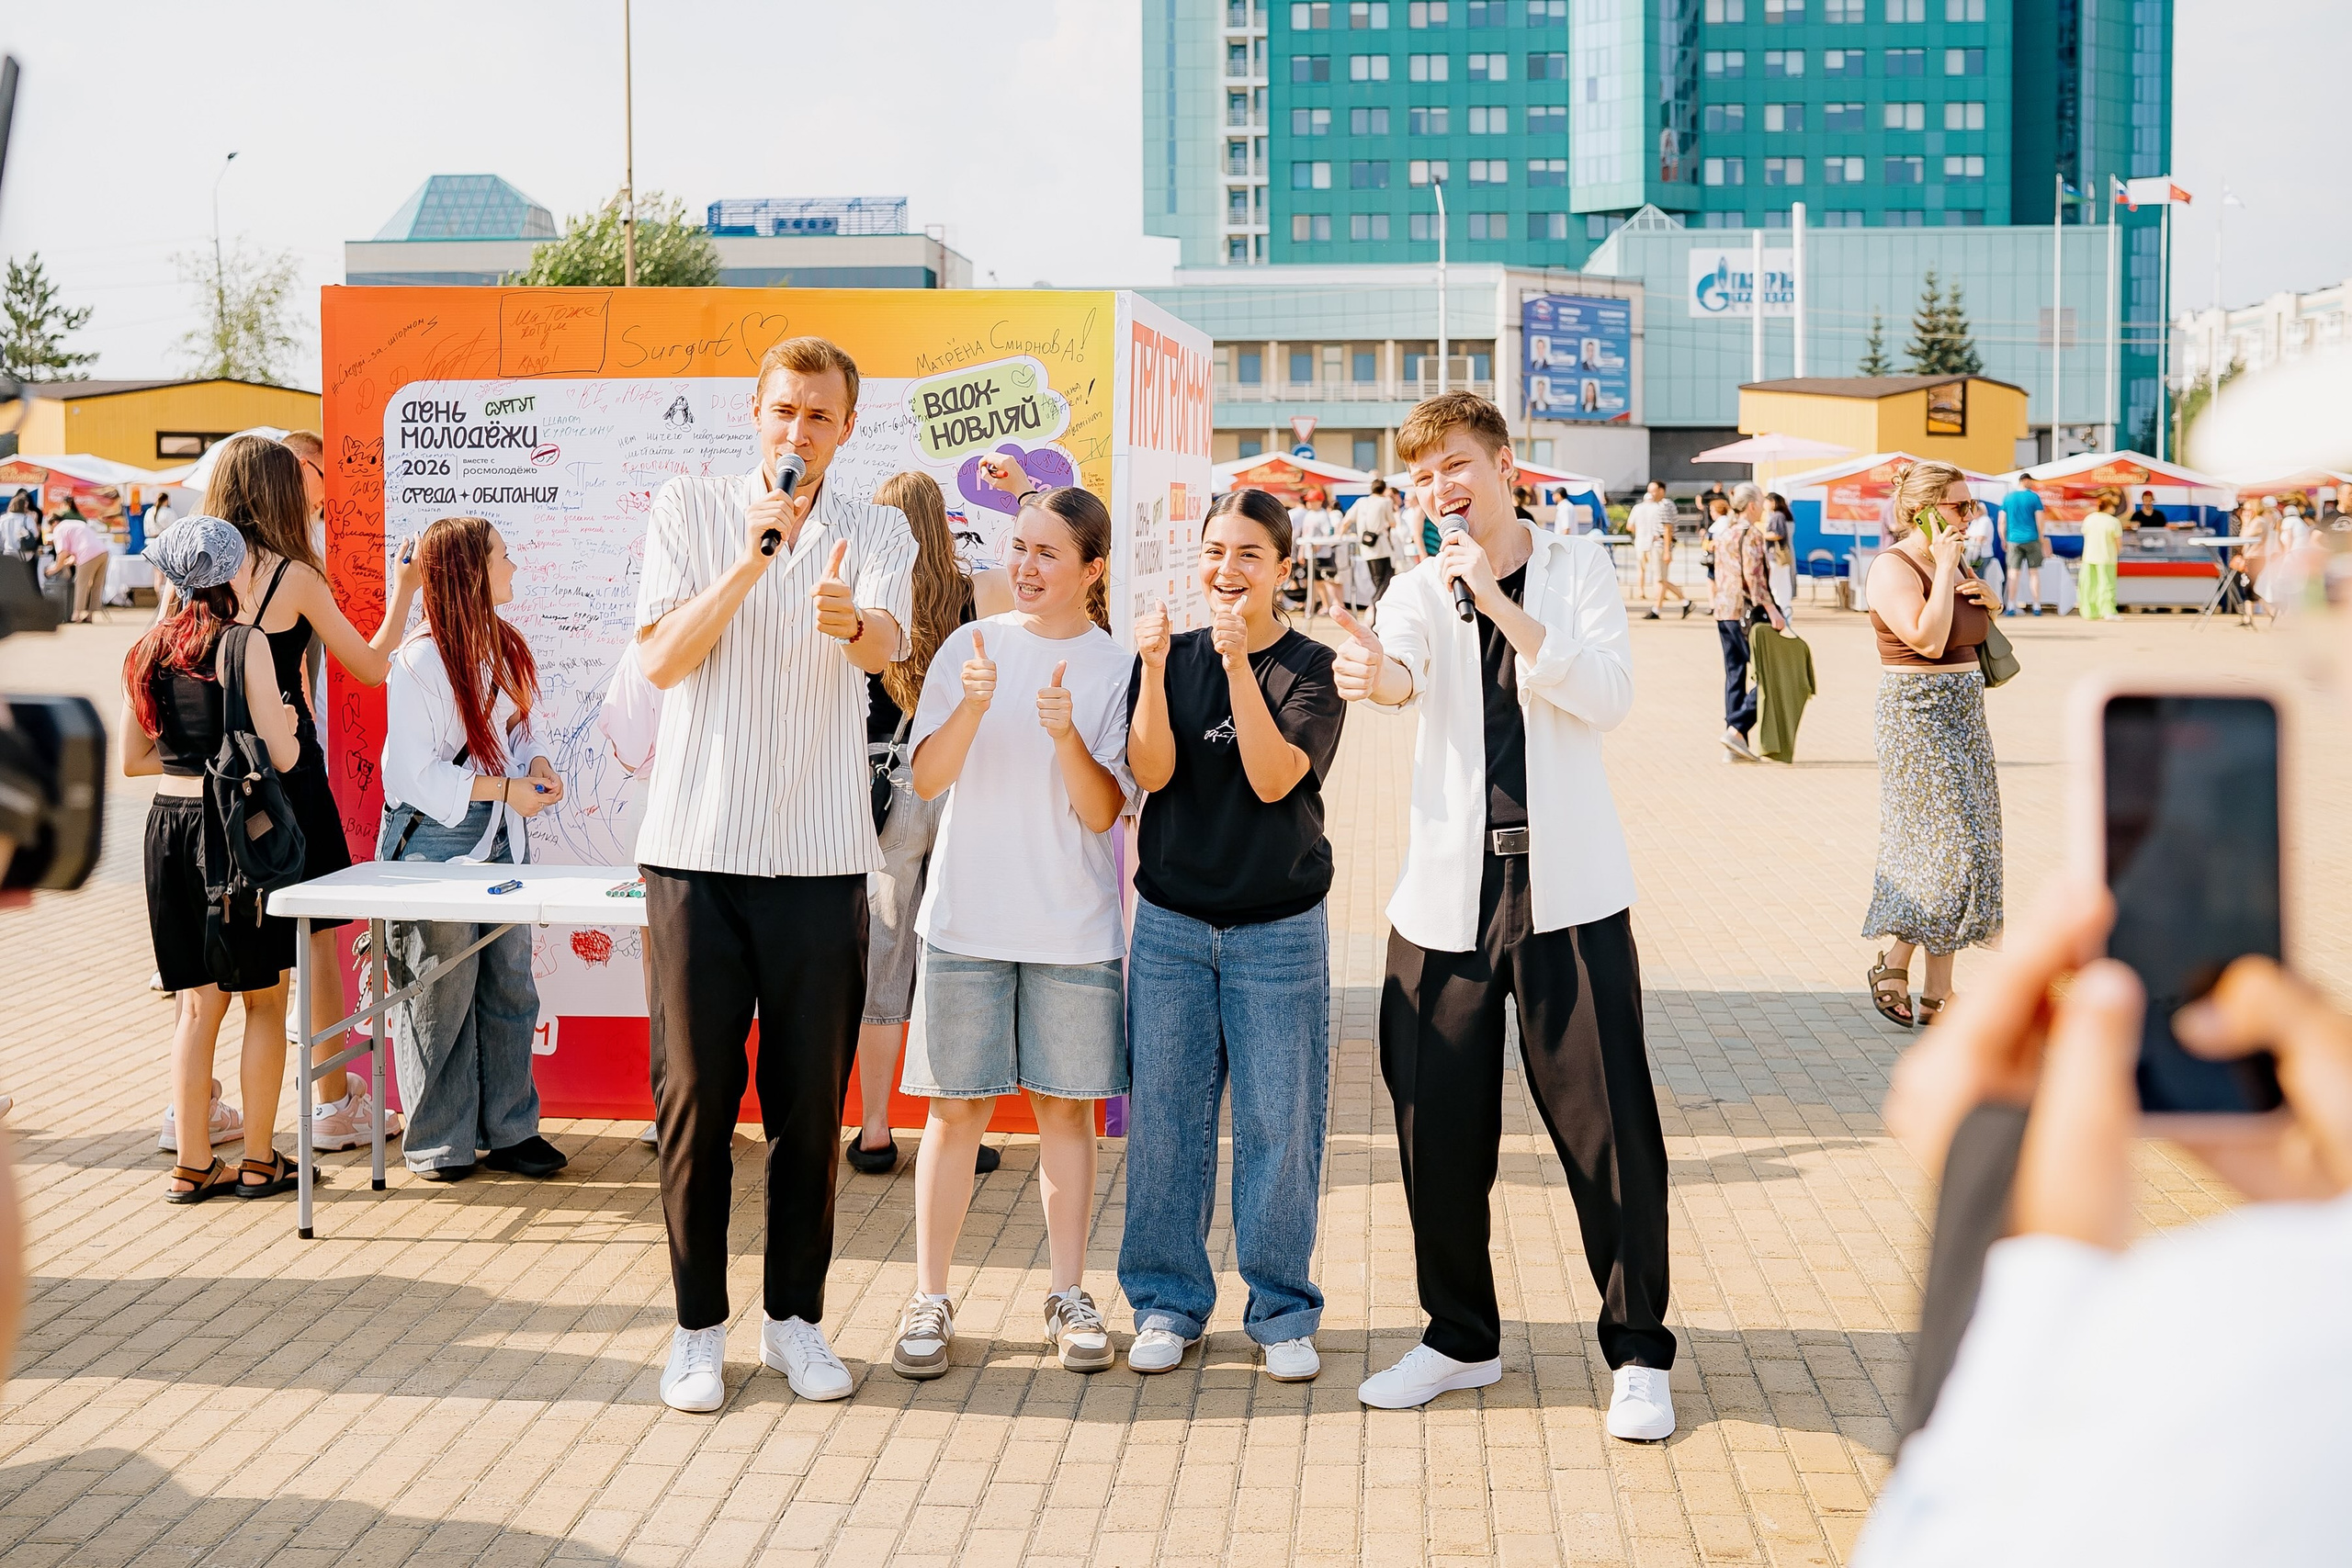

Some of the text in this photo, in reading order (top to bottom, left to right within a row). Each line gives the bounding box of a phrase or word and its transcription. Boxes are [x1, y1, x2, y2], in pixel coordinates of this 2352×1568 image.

[618, 321, 734, 374] Surgut
[401, 396, 536, 423] ДЕНЬ СУРГУТ
[922, 378, 1001, 419] ВДОХ-
[401, 421, 538, 450] МОЛОДЁЖИ
[931, 395, 1041, 450] НОВЛЯЙ
[401, 459, 451, 477] 2026
[462, 466, 538, 479] росмолодёжь
[401, 487, 458, 504] СРЕДА
[472, 487, 559, 504] ОБИТАНИЯ
